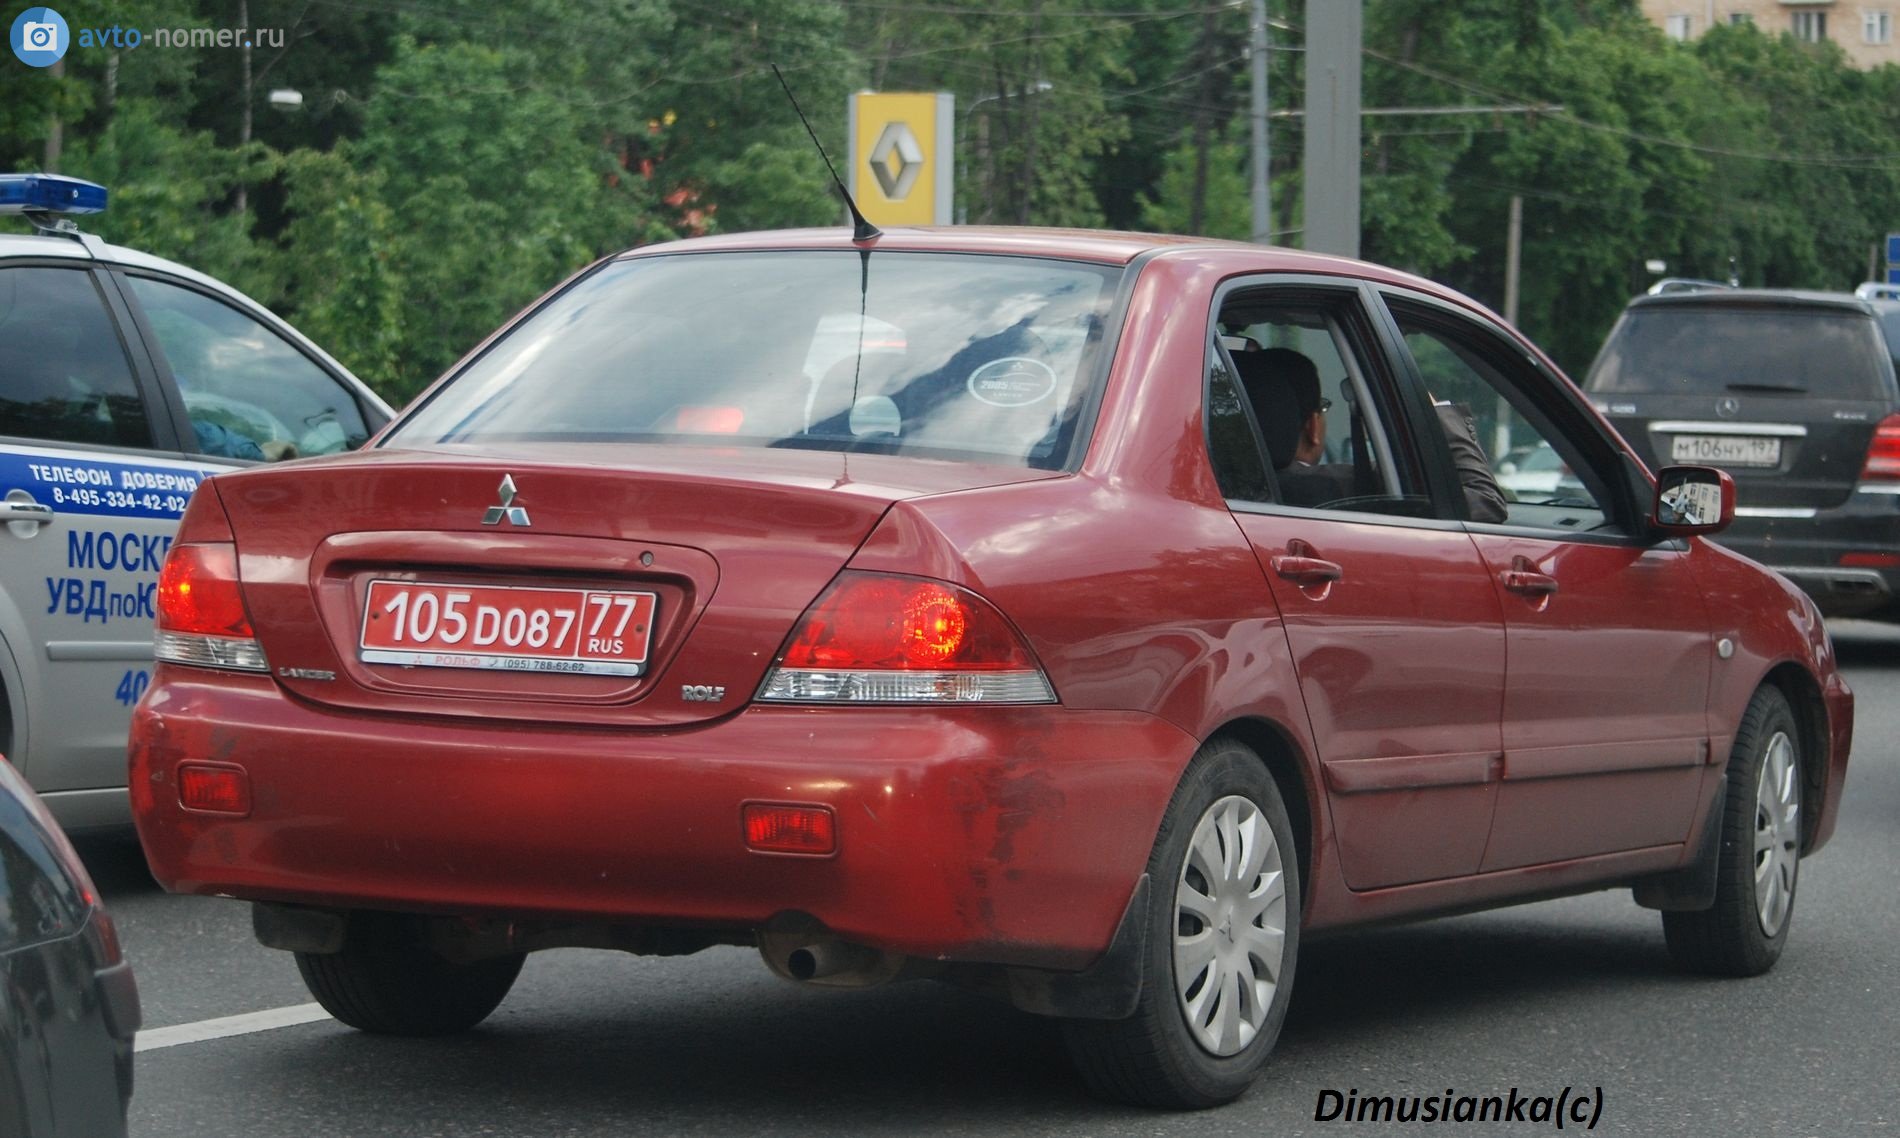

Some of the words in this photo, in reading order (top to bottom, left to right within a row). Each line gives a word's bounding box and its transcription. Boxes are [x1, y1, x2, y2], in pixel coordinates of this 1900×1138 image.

[29, 464, 113, 487] ТЕЛЕФОН
[121, 470, 198, 492] ДОВЕРИЯ
[53, 487, 186, 512] 8-495-334-42-02
[588, 596, 637, 638] 77
[587, 639, 624, 655] RUS
[435, 655, 481, 668] РОЛЬФ
[503, 659, 530, 670] (095)
[534, 660, 585, 673] 788-62-62
[682, 685, 725, 702] ROLF
